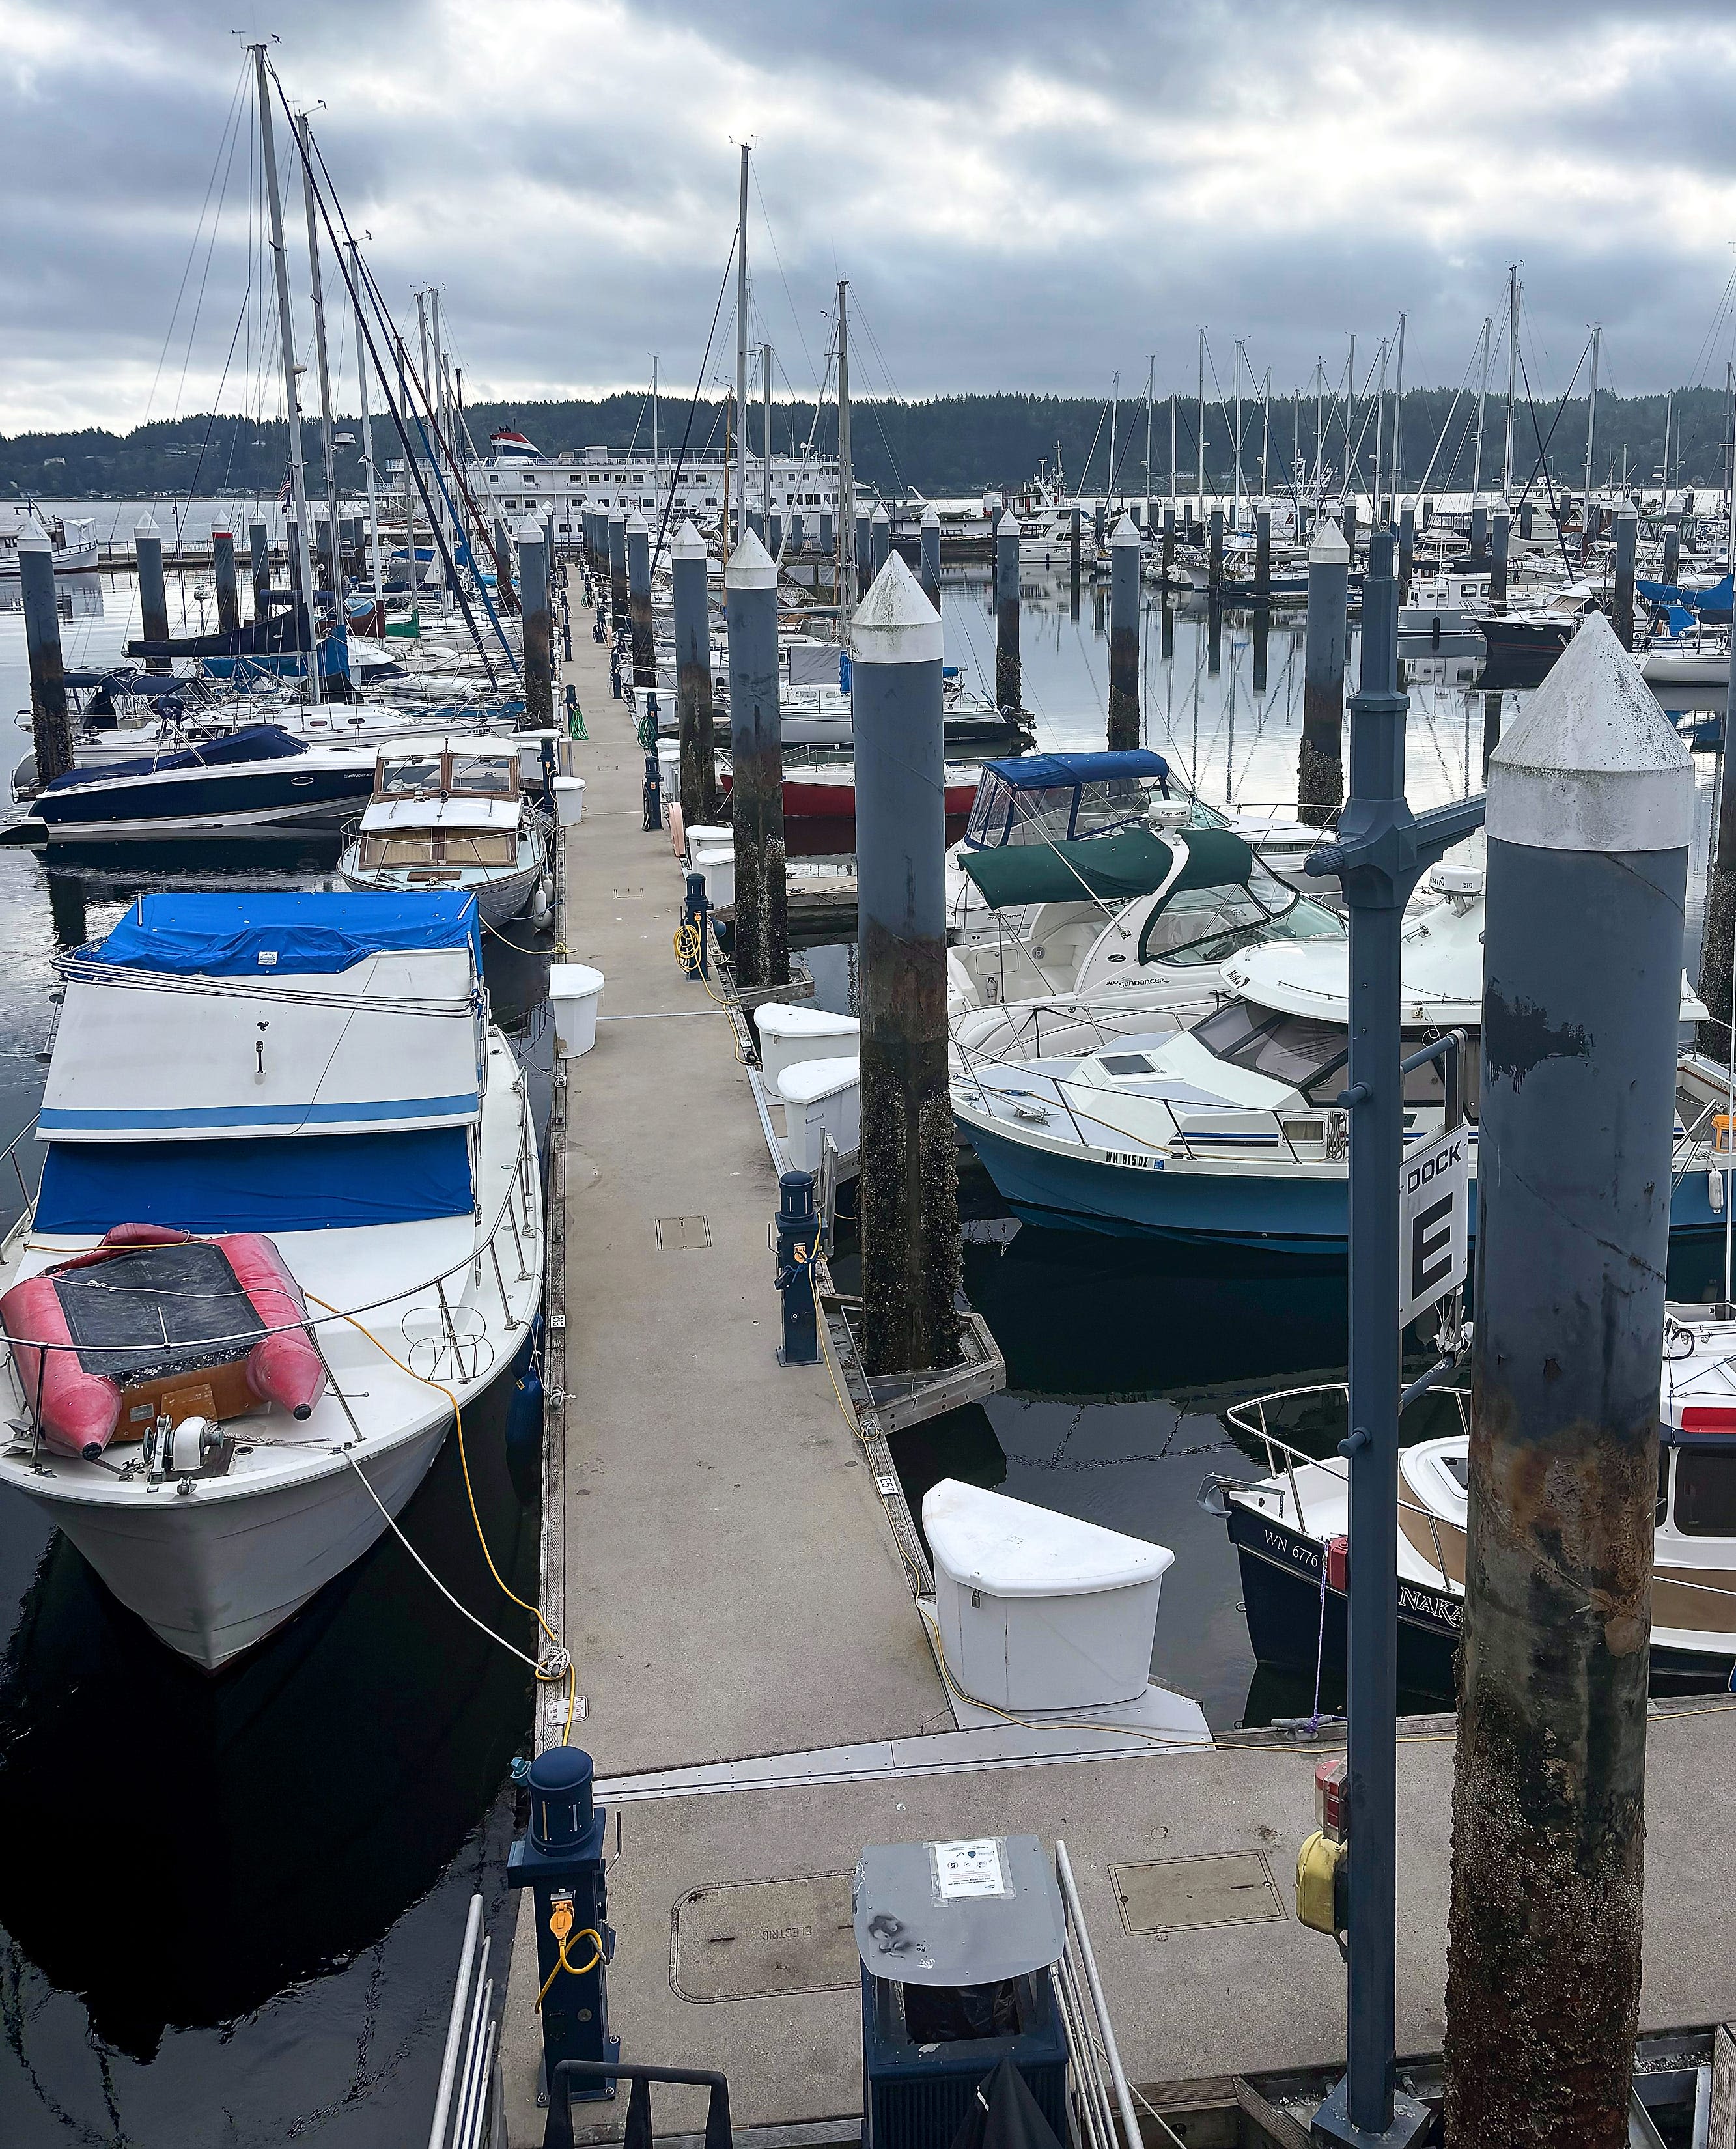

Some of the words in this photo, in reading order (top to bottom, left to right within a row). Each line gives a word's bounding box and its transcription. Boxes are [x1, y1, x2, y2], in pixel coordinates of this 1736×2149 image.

[1407, 1140, 1462, 1196] DOCK
[1412, 1192, 1453, 1302] E
[880, 1478, 895, 1491] E57
[1265, 1529, 1288, 1552] WN
[1293, 1545, 1319, 1567] 6776
